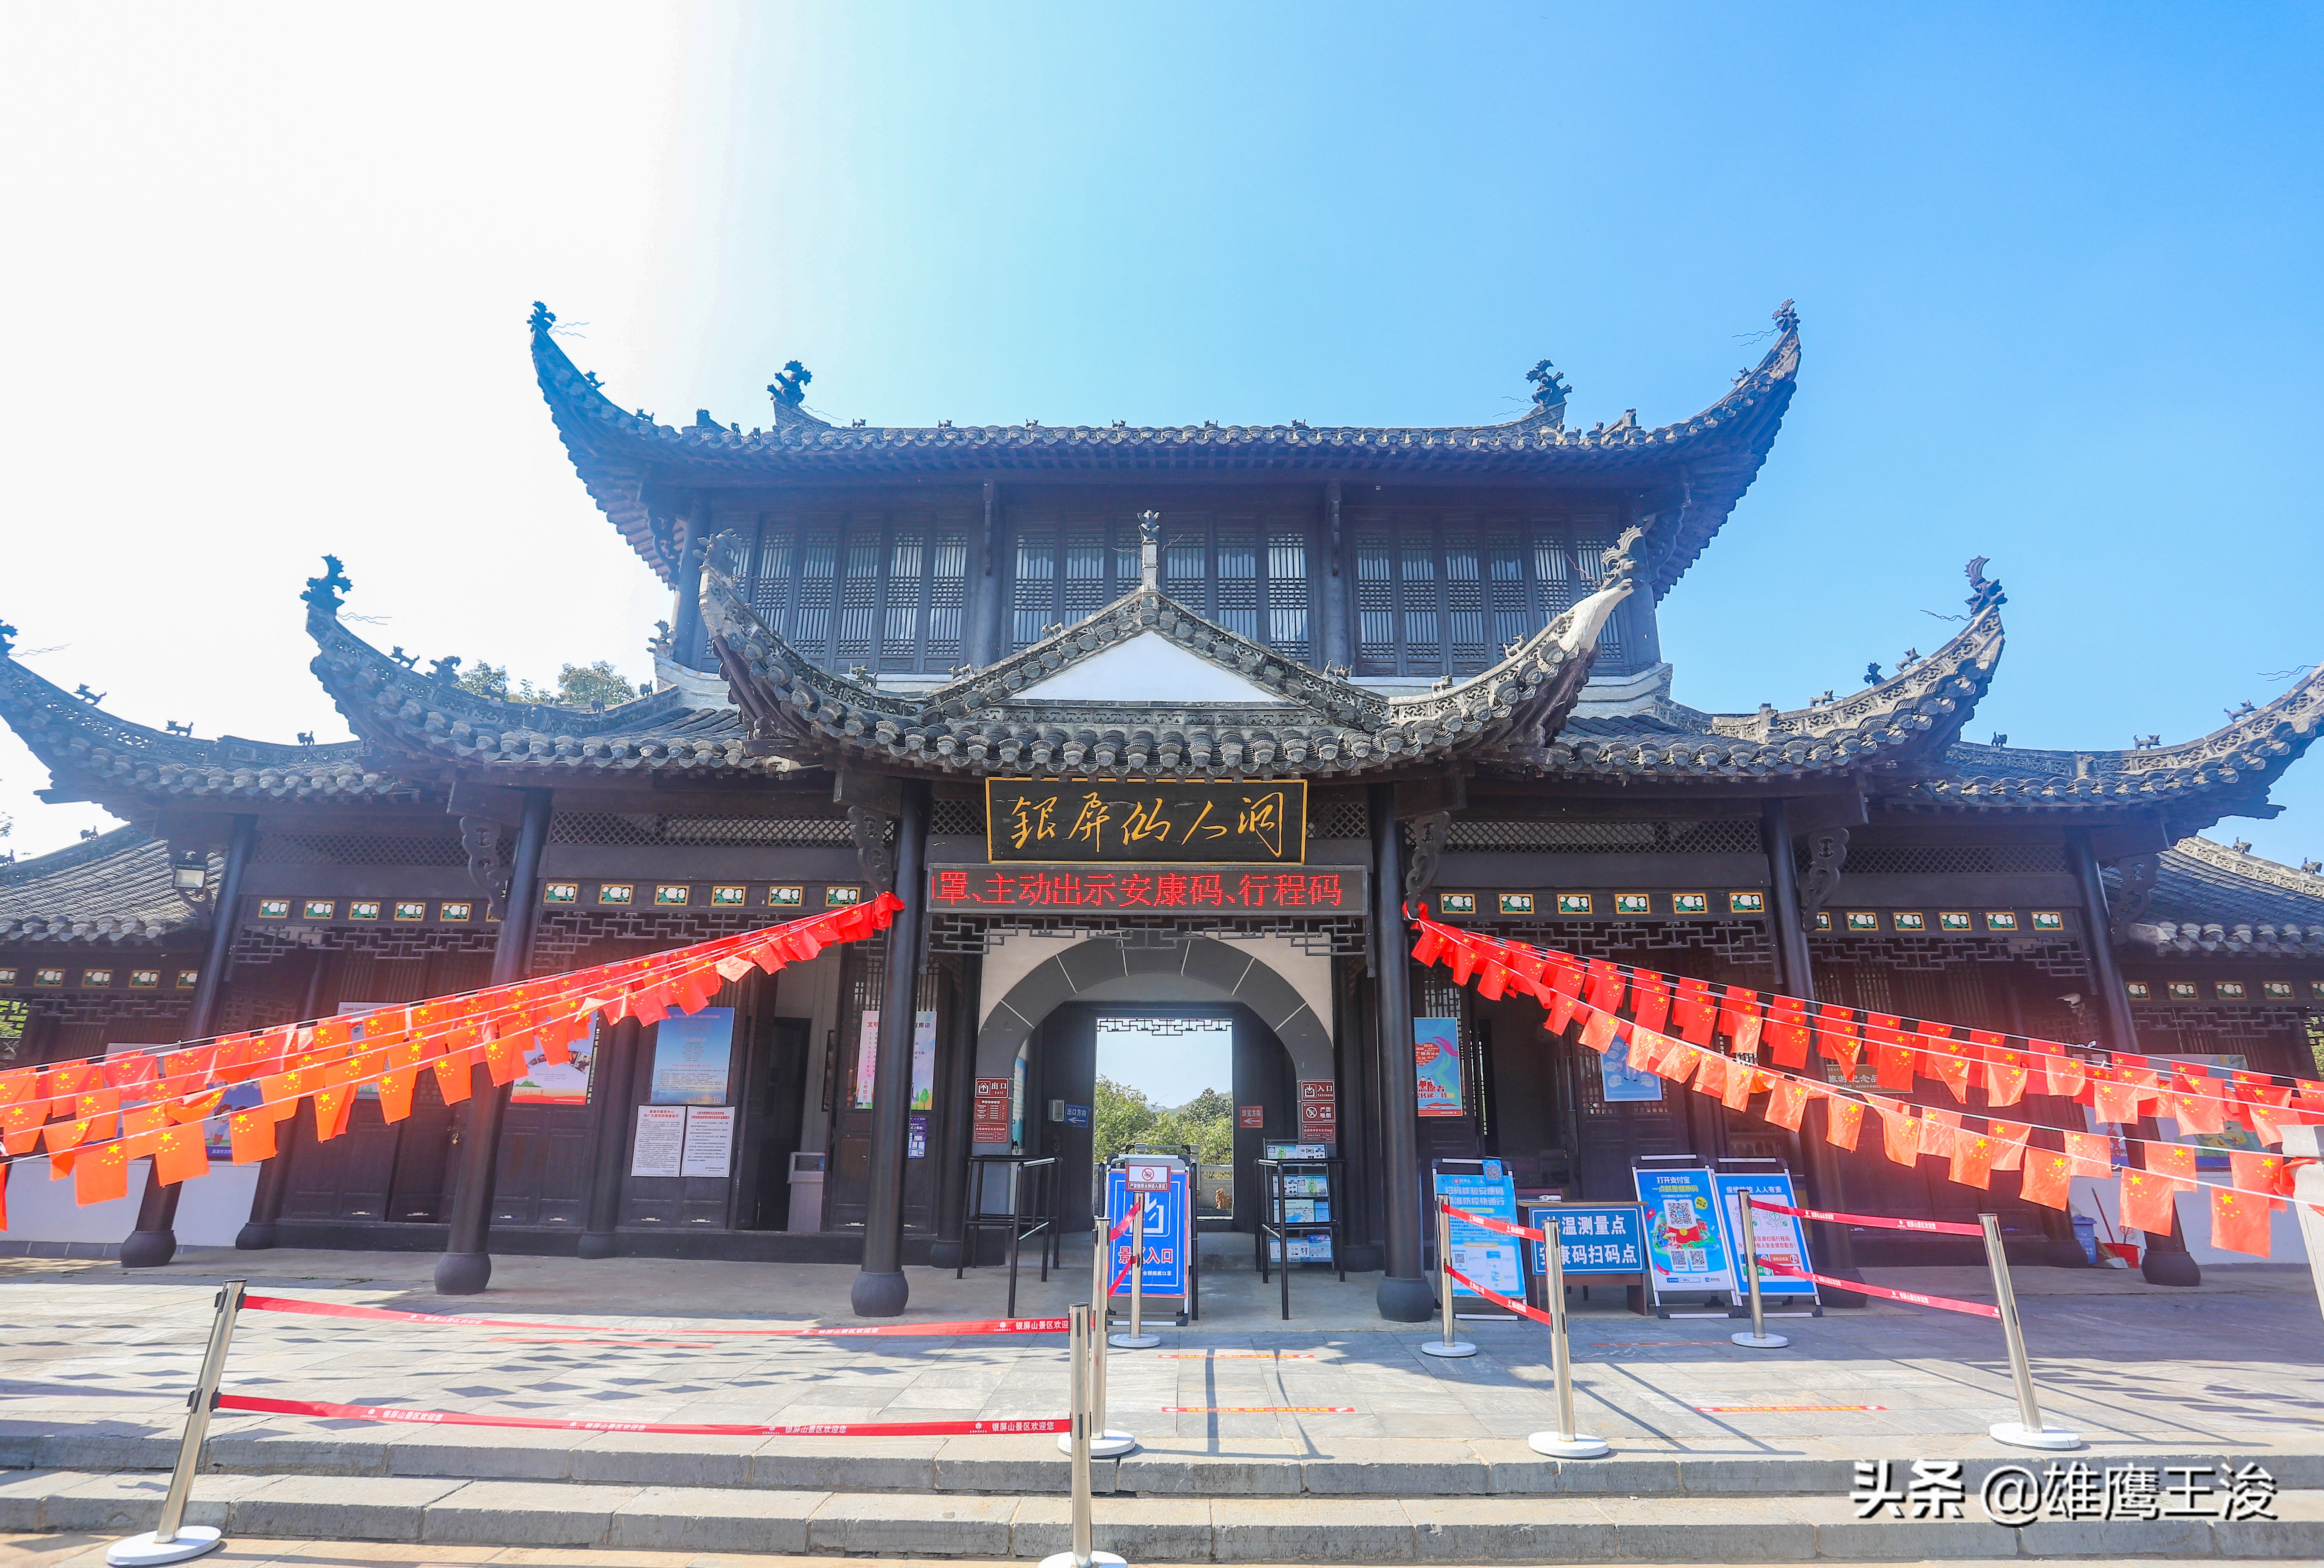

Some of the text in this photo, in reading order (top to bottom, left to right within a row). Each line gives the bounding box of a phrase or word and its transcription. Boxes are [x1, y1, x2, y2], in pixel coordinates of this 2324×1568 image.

[931, 871, 1343, 907] 罩、主动出示安康码、行程码
[1067, 1108, 1087, 1117] 出口方向
[1241, 1109, 1261, 1117] 游览方向
[1445, 1187, 1504, 1195] 扫码核验安康码
[1547, 1215, 1626, 1236] 温测量点
[1118, 1246, 1173, 1264] 景入口
[382, 1409, 1055, 1434] 银屏山景区欢迎您 银屏山景区欢迎您 银屏山景区欢迎您 银屏山景区欢迎您
